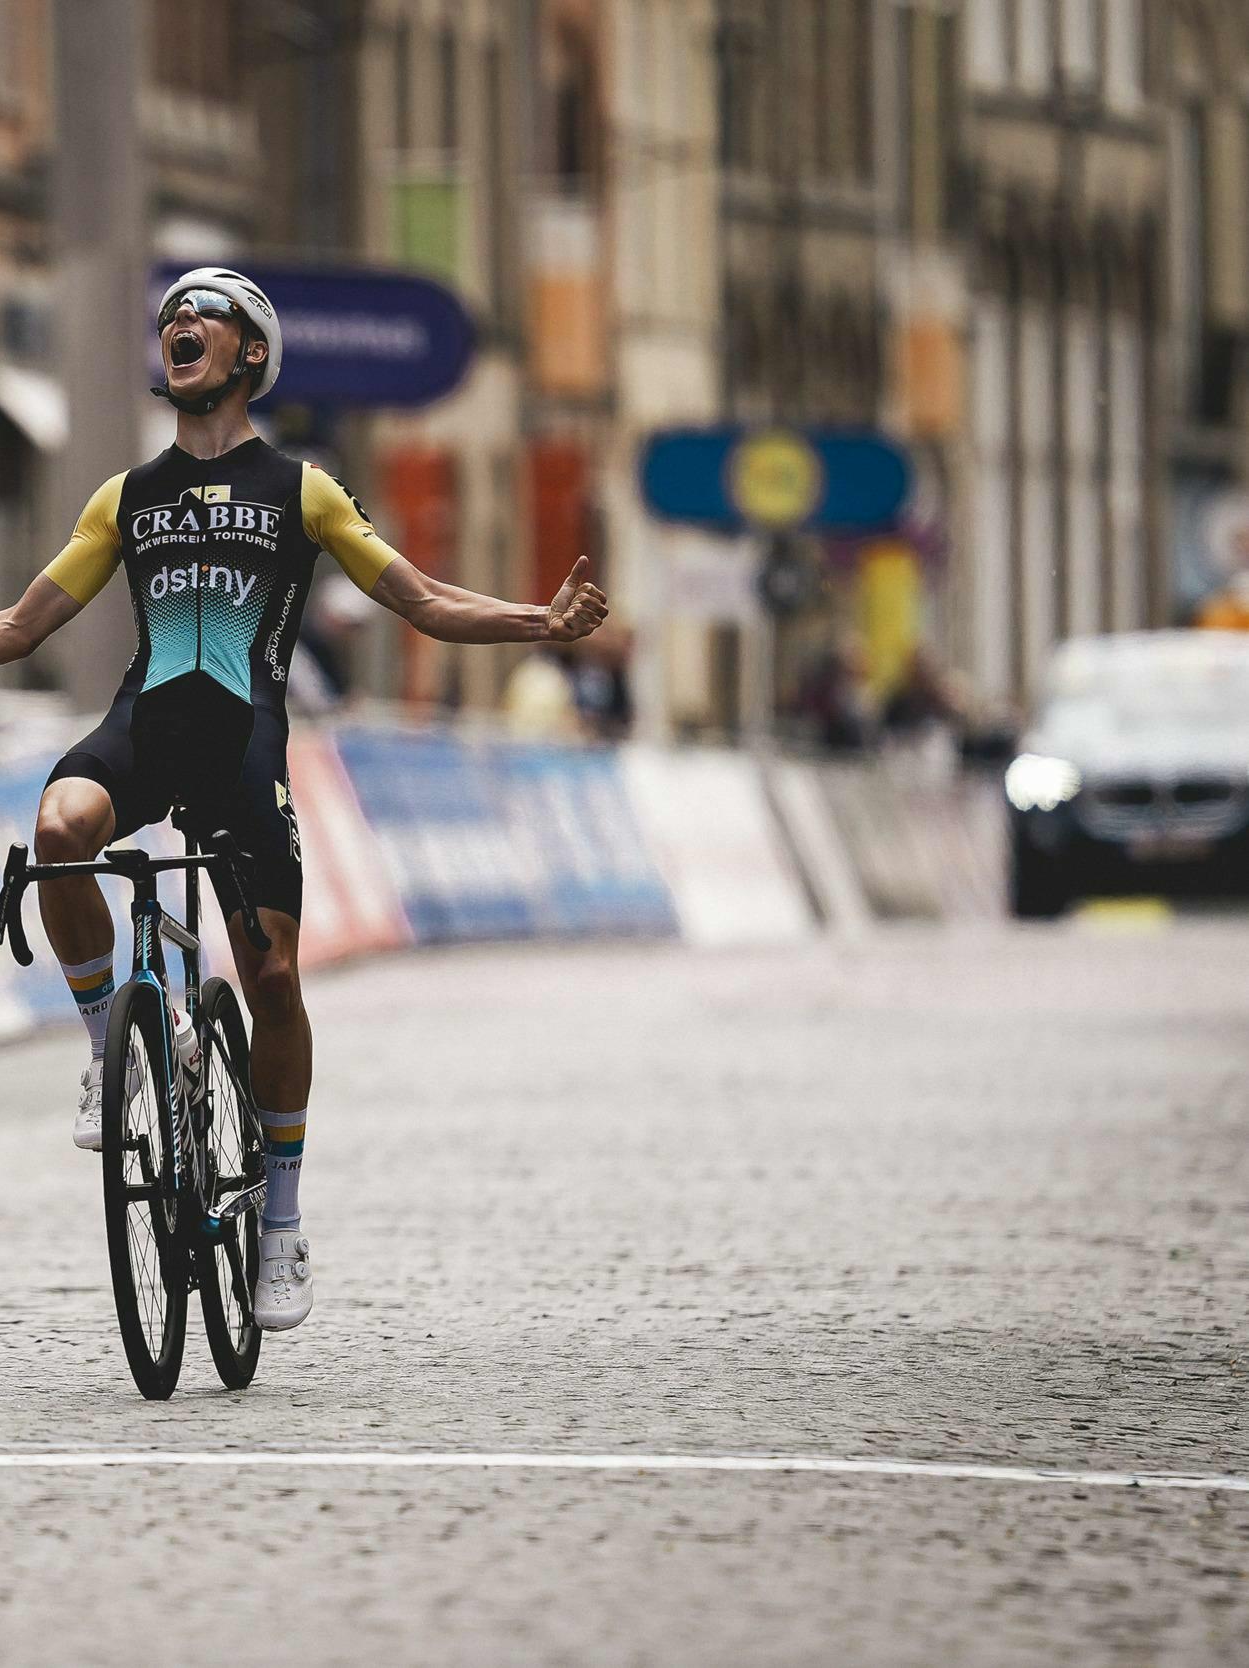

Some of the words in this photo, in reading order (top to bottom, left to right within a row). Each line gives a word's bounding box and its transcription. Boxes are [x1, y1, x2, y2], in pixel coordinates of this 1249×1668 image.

[132, 505, 280, 540] CRABBE
[135, 533, 206, 555] DAKWERKEN
[213, 531, 277, 552] TOITURES
[269, 583, 297, 665] voyamundo
